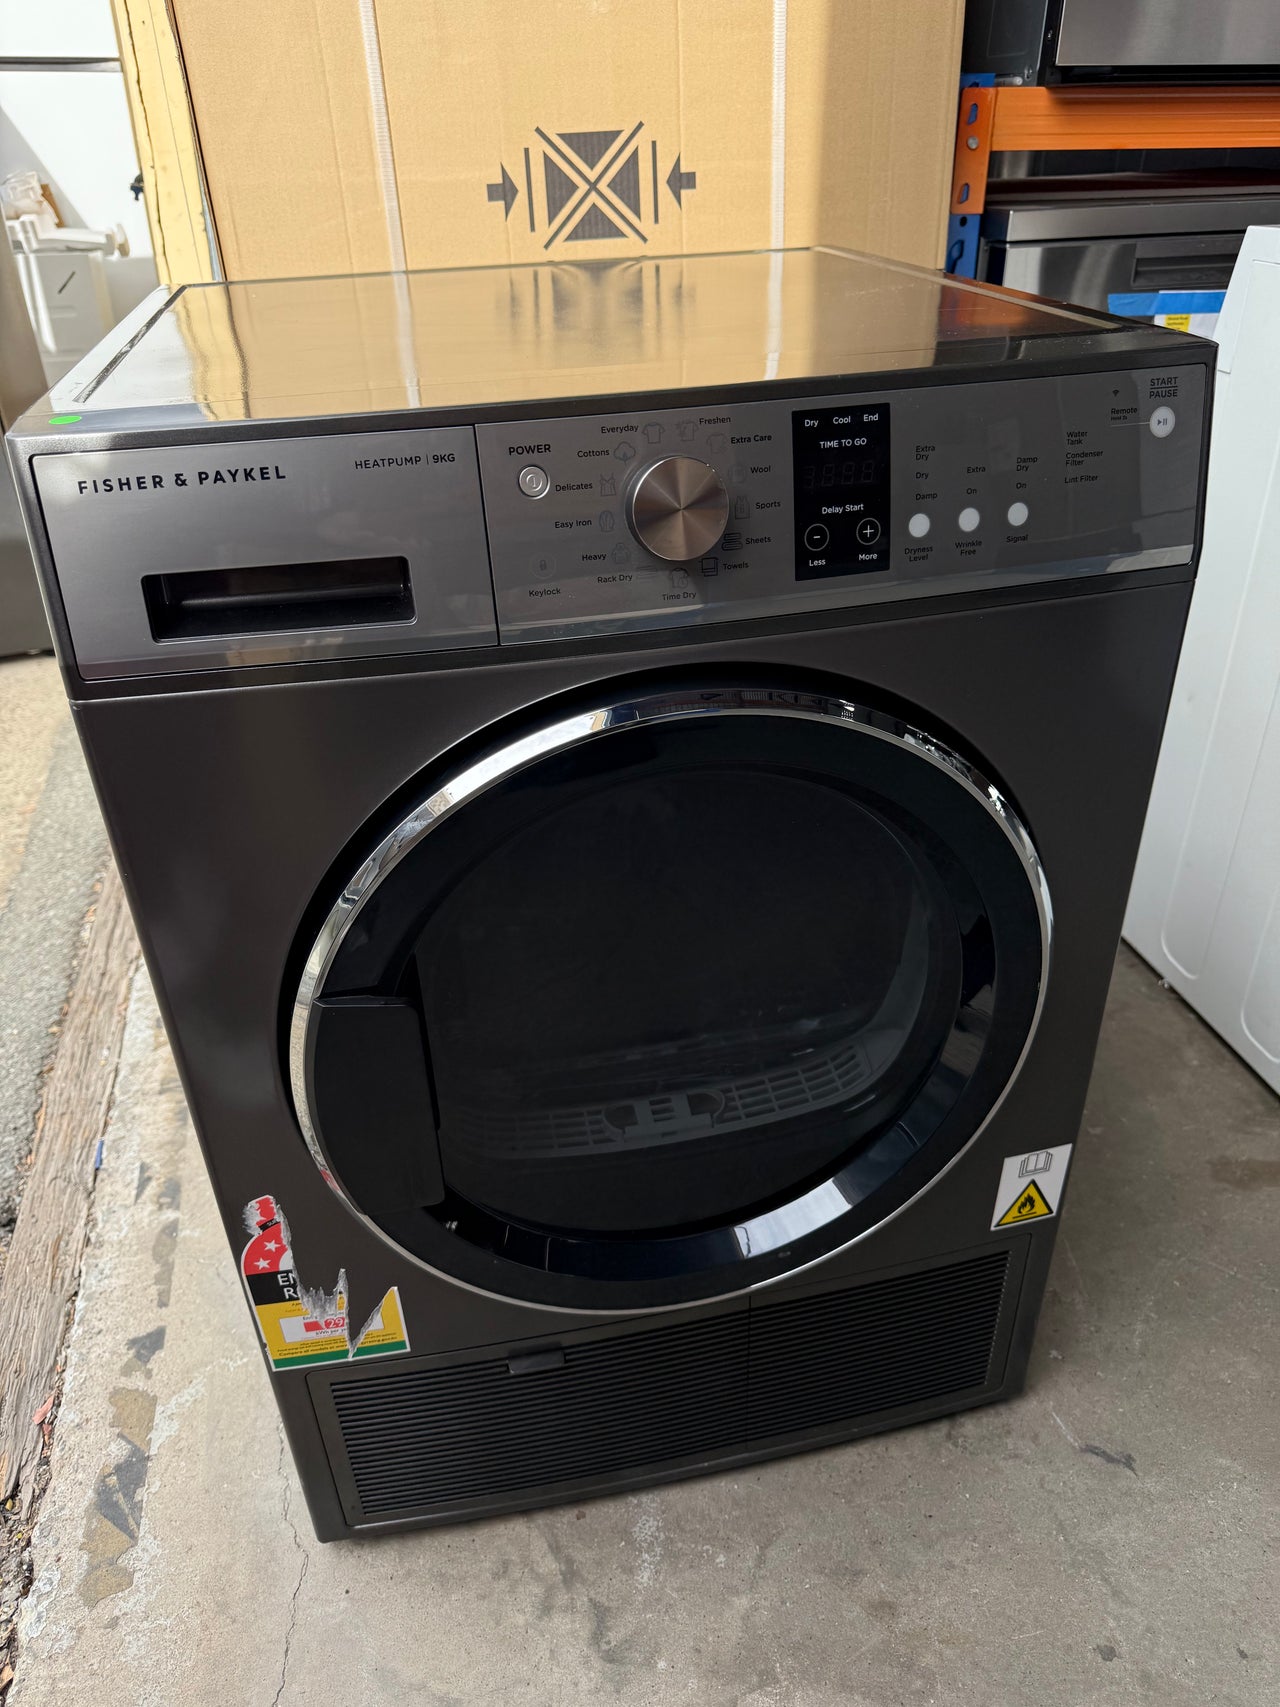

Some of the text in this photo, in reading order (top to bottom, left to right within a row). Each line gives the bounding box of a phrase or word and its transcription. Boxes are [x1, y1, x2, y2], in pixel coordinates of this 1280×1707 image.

[1150, 377, 1178, 387] START
[1150, 389, 1178, 399] PAUSE
[1110, 407, 1138, 415] Remote
[699, 416, 731, 424] Freshen
[804, 413, 878, 428] Dry Cool End
[601, 424, 638, 434] Everyday
[1066, 430, 1088, 438] Water
[731, 433, 772, 444] Extra Care
[820, 437, 867, 448] TIME TO GO
[508, 444, 552, 456] POWER
[577, 448, 610, 458] Cottons
[916, 444, 936, 453] Extra
[916, 453, 929, 461] Dry
[1066, 450, 1103, 459] Condenser
[354, 453, 456, 470] HEATPUMP 9KG
[1017, 456, 1038, 464] Damp
[1066, 458, 1084, 466] Filter
[750, 465, 771, 474] Wool
[1017, 464, 1029, 472] Dry
[78, 465, 287, 494] FISHER & PAYKEL
[916, 472, 929, 480] Dry
[1064, 474, 1098, 484] Lint Filter
[555, 482, 593, 492] Delicates
[916, 492, 938, 501] Damp
[756, 500, 781, 510] Sports
[822, 503, 864, 515] Delay Start
[555, 518, 592, 530] Easy Iron
[745, 535, 771, 545] Sheets
[1006, 534, 1028, 543] Signal
[955, 540, 982, 549] Wrinkle
[904, 546, 933, 555] Dryness
[960, 548, 977, 556] Free
[582, 552, 606, 562] Heavy
[809, 552, 878, 567] Less More
[909, 554, 928, 562] Level
[723, 561, 749, 571] Towels
[598, 573, 633, 584] Rack Dry
[528, 587, 561, 598] Keylock
[662, 591, 697, 601] Time Dry
